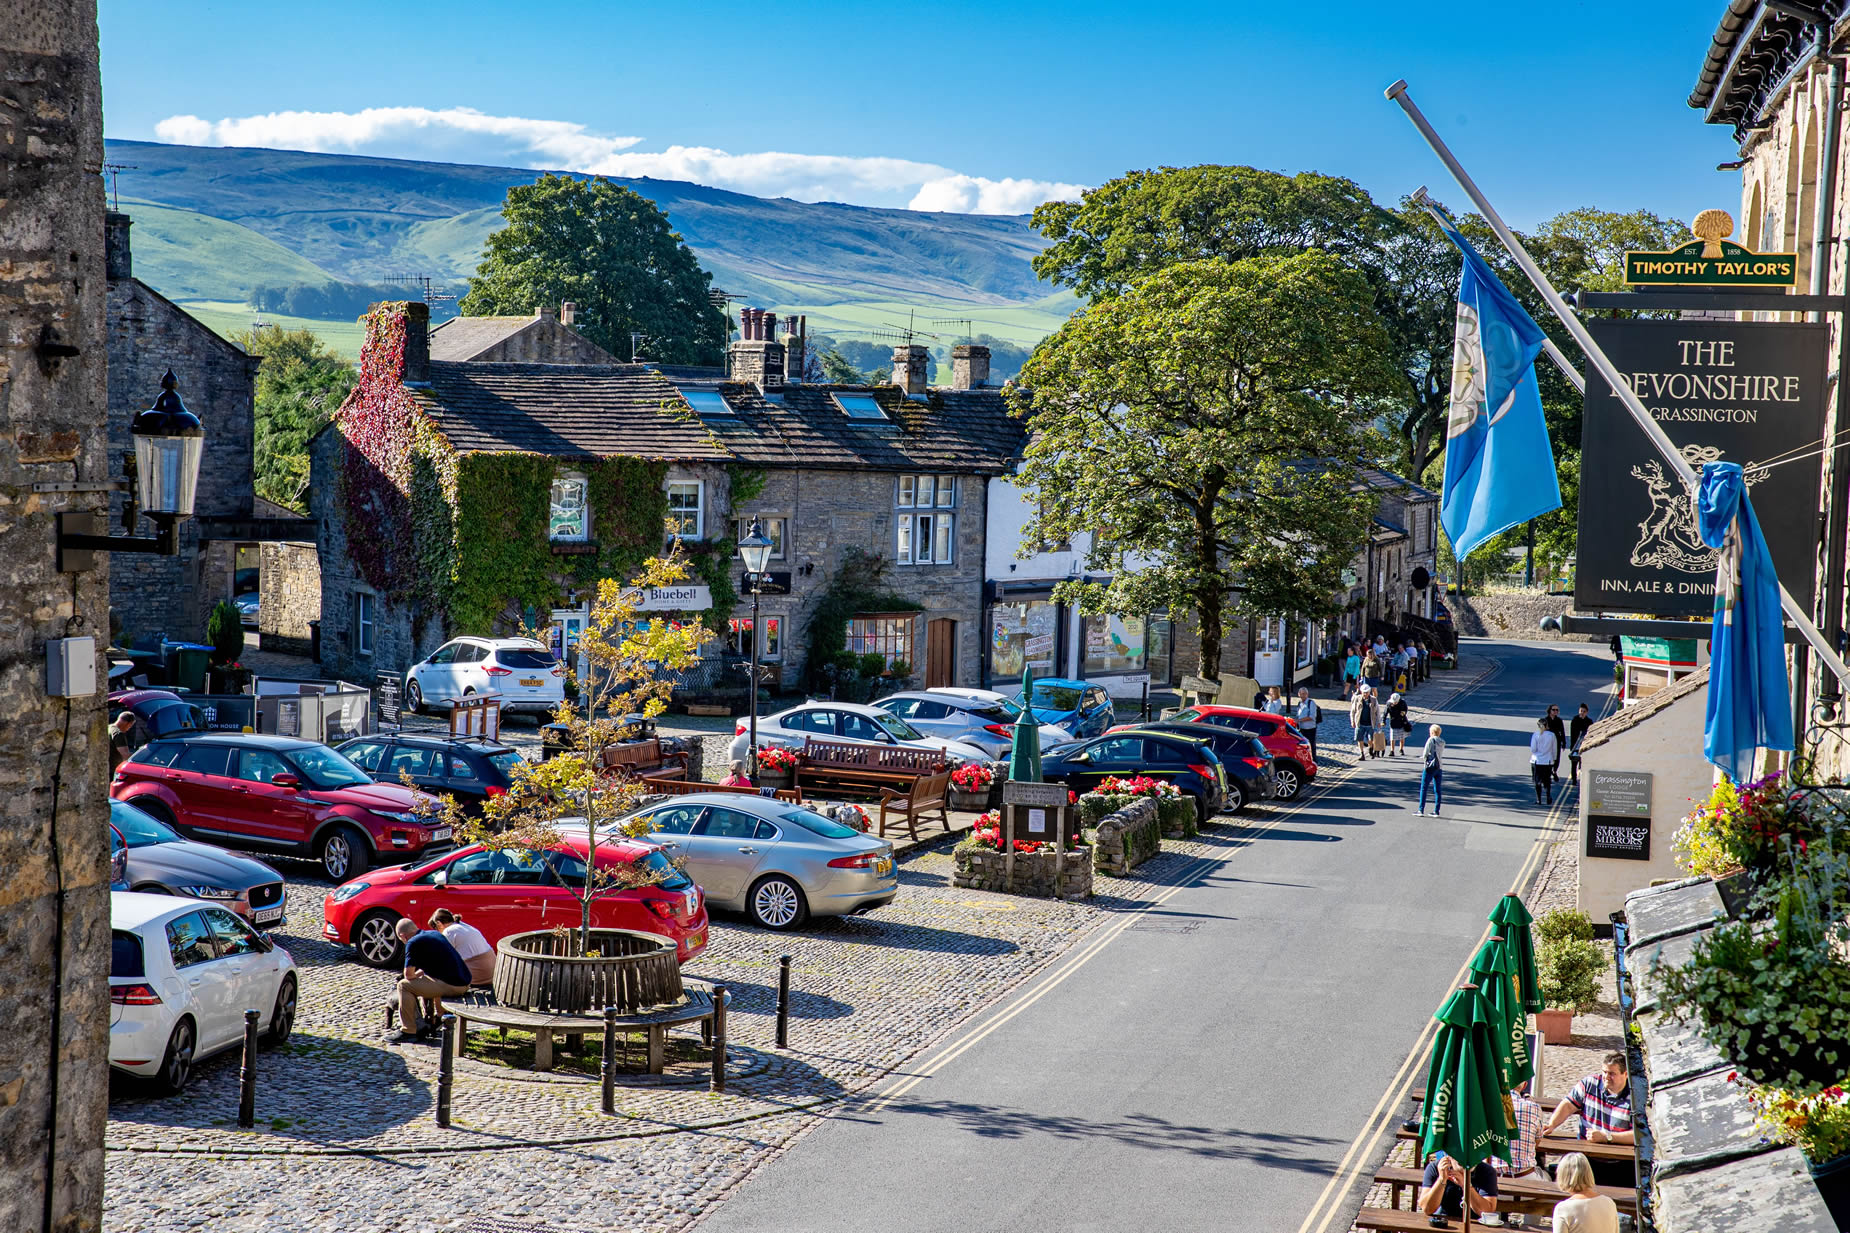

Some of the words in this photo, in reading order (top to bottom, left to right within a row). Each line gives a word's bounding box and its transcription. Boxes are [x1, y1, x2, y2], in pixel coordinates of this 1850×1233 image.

[1633, 261, 1708, 275] TIMOTHY
[1715, 262, 1791, 277] TAYLOR'S
[1678, 340, 1735, 367] THE
[1650, 407, 1758, 424] GRASSINGTON
[651, 588, 697, 600] Bluebell
[1601, 579, 1631, 593] INN,
[1634, 581, 1660, 593] ALE
[1664, 582, 1674, 594] &
[1678, 582, 1717, 595] DININ
[1595, 774, 1647, 787] Grassington
[1595, 835, 1643, 845] MIRRORS
[1596, 828, 1633, 838] SMOKE
[1431, 1078, 1453, 1136] TIMOT
